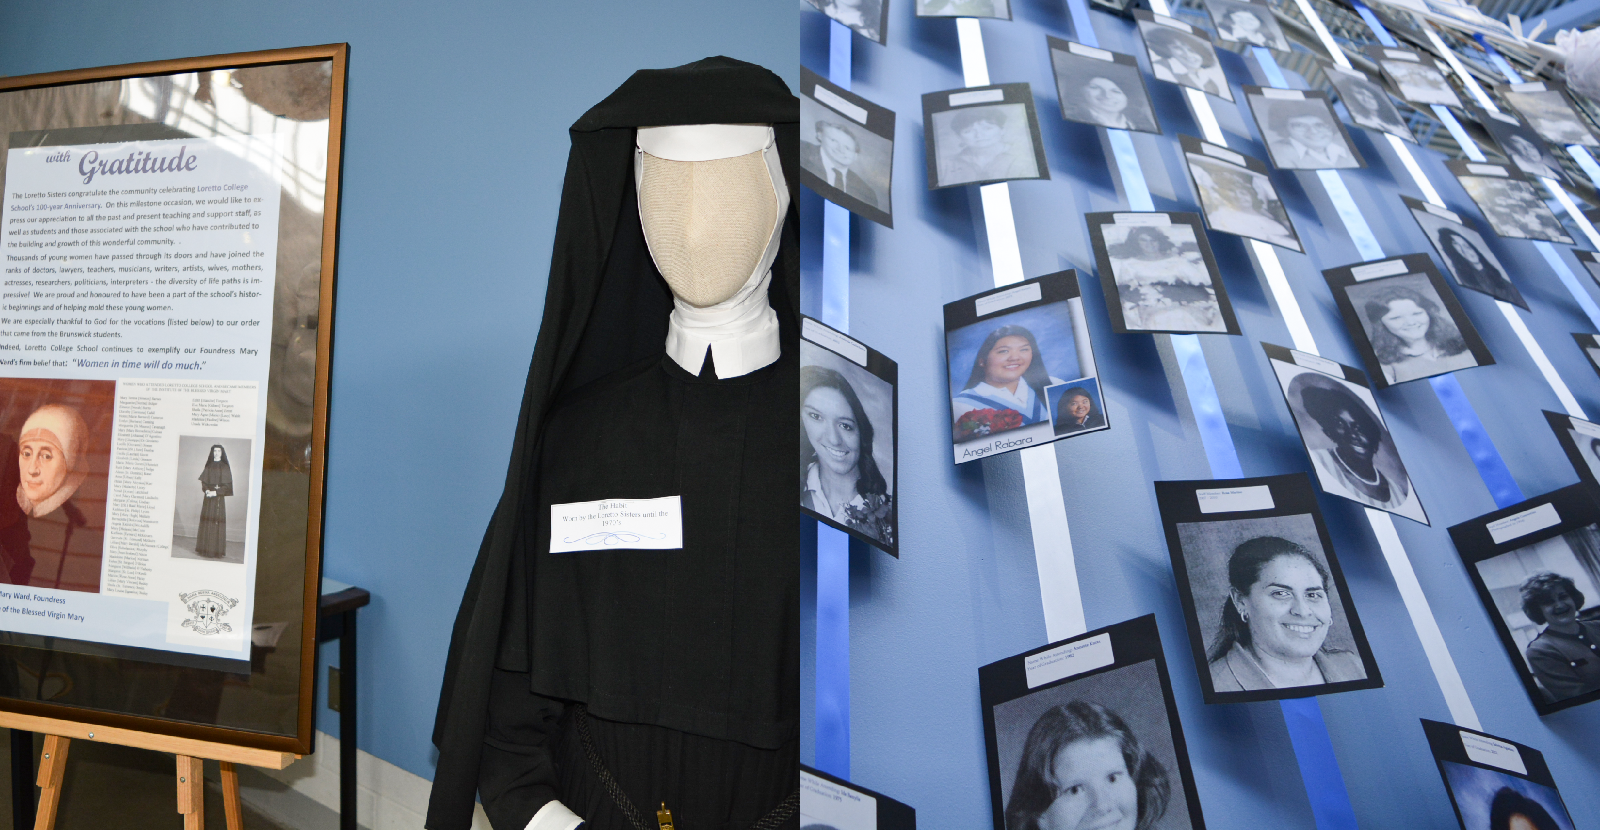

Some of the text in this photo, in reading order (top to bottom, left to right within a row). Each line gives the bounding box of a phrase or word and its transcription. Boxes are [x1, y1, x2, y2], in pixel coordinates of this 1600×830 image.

[46, 146, 197, 184] with Gratitude
[24, 183, 249, 199] Loretto Sisters congratulate community celebrating Loretto College
[129, 199, 162, 207] milestone
[207, 196, 229, 204] would
[38, 215, 77, 225] appreciation
[107, 214, 121, 223] past
[136, 213, 161, 222] present
[162, 212, 191, 221] teaching
[206, 211, 234, 220] support
[90, 226, 124, 234] associated
[210, 223, 251, 231] contributed
[18, 240, 44, 249] building
[57, 239, 80, 249] growth
[111, 252, 134, 262] passed
[136, 252, 162, 261] through
[228, 251, 251, 260] joined
[110, 279, 149, 287] interpreters
[168, 278, 198, 287] diversity
[221, 277, 242, 287] paths
[56, 291, 76, 300] proud
[172, 291, 187, 300] part
[8, 303, 41, 313] beginnings
[63, 303, 87, 312] helping
[24, 318, 56, 327] especially
[167, 319, 189, 328] (listed
[190, 319, 215, 328] below)
[50, 344, 74, 354] College
[147, 346, 181, 355] exemplify
[239, 347, 259, 356] Mary
[122, 361, 142, 369] time
[144, 360, 161, 369] will
[963, 437, 1032, 458] Angel Rabara
[14, 592, 31, 601] Ward,
[34, 595, 65, 604] Foundress
[22, 608, 45, 616] Blessed
[48, 611, 65, 620] Virgin
[68, 613, 84, 622] Mary
